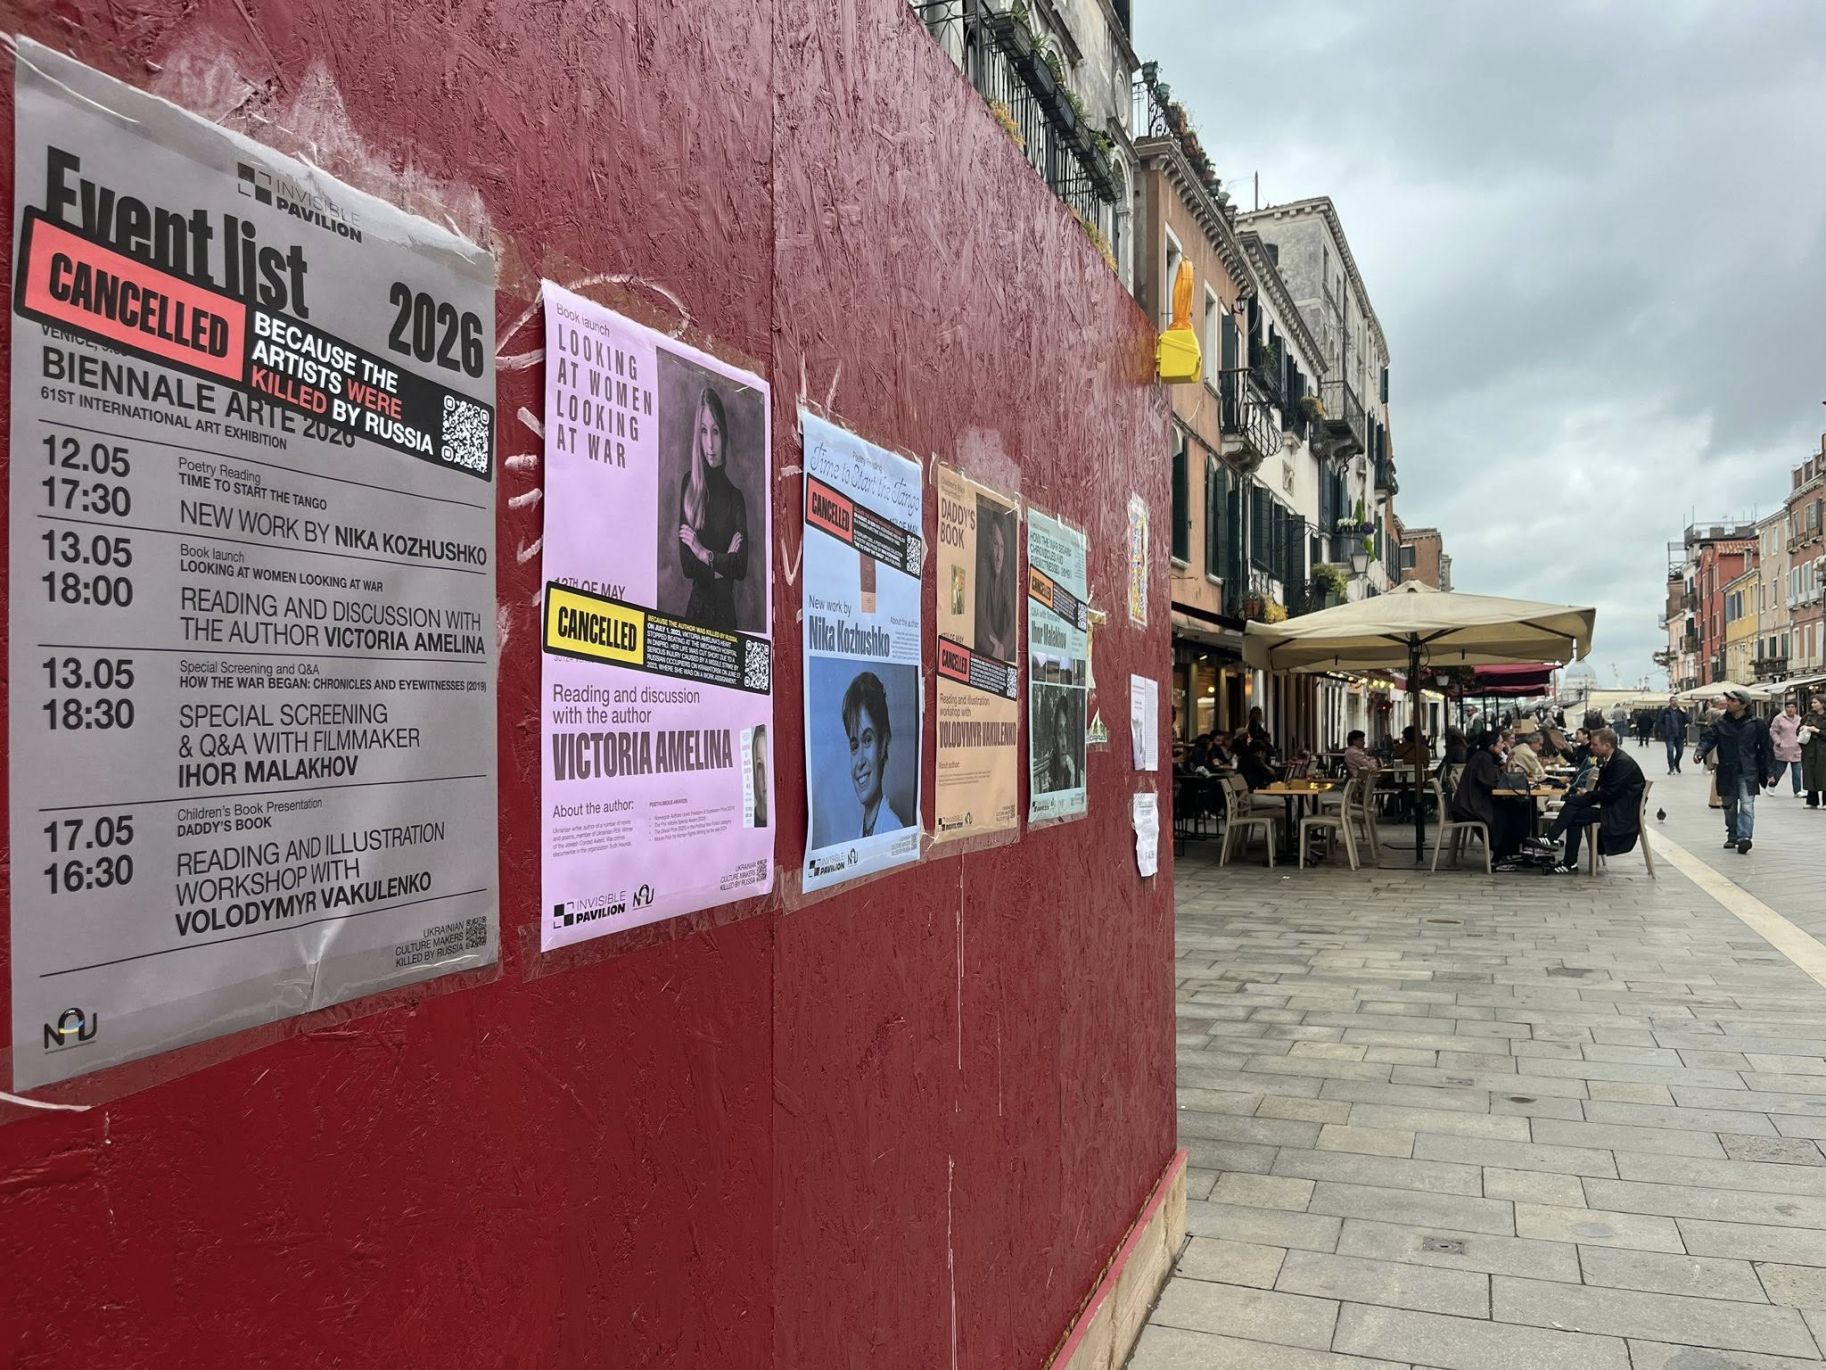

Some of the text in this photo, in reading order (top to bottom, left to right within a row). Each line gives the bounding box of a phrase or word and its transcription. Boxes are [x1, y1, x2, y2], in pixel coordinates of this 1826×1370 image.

[276, 196, 362, 243] PAVILION
[277, 179, 361, 224] INVISIBLE
[47, 145, 309, 319] Event list
[49, 252, 229, 358] CANCELLED
[556, 303, 610, 338] Book launch
[388, 281, 484, 379] 2026
[254, 311, 399, 393] BECAUSE THE
[558, 323, 638, 381] LOOKING
[43, 345, 216, 414] BIENNALE
[225, 391, 295, 434] ARTE
[251, 340, 402, 420] ARTISTS WERE
[557, 357, 652, 416] AT WOMEN
[41, 386, 287, 450] 61ST INTERNATIONAL ART EXHIBITION
[251, 365, 434, 455] KILLED BY RUSSIA
[556, 390, 639, 442] LOOKING
[42, 434, 131, 478] 12.05
[556, 424, 626, 469] AT WAR
[178, 457, 261, 486] Poetry Reading
[810, 443, 838, 479] Time
[841, 464, 849, 483] to
[851, 464, 876, 494] Start
[892, 477, 919, 518] Tango
[42, 476, 131, 517] 17:30
[178, 473, 327, 511] TIME TO START THE TANGO
[811, 492, 849, 533] CANCELLED
[941, 497, 976, 531] DADDY'S
[42, 529, 132, 568] 13.05
[180, 500, 487, 566] NEW WORK BY NIKA KOZHUSHKO
[940, 522, 965, 550] BOOK
[180, 544, 245, 563] Book launch
[42, 571, 133, 608] 18:00
[180, 559, 383, 593] LOOKING AT WOMEN LOOKING AT WAR
[601, 583, 626, 600] MAY
[181, 587, 481, 632] READING AND DISCUSSION WITH
[809, 594, 852, 617] New work by
[180, 617, 486, 655] THE AUTHOR VICTORIA AMELINA
[557, 606, 637, 652] CANCELLED
[678, 621, 696, 631] AUTHOR
[809, 615, 835, 652] Nika
[837, 620, 890, 658] Kozhushko
[43, 657, 134, 689] 13.05
[180, 660, 319, 677] Special Screening and Q&A
[180, 676, 487, 693] HOW THE WAR BEGAN: CHRONICLES AND EYEWITNESSES (2019)
[43, 698, 134, 730] 18:30
[553, 684, 700, 706] Reading and discussion
[179, 703, 388, 728] SPECIAL SCREENING
[553, 707, 652, 724] with the author
[940, 721, 982, 748] VOLODYMYR
[179, 728, 420, 758] & Q&A WITH FILMMAKER
[552, 729, 733, 781] VICTORIA AMELINA
[178, 755, 358, 788] IHOR MALAKHOV
[177, 797, 323, 823] Children's Book Presentation
[177, 816, 272, 838] DADDY'S BOOK
[553, 804, 583, 818] About
[586, 802, 601, 814] the
[603, 800, 634, 813] author:
[43, 814, 134, 852] 17.05
[177, 821, 445, 877] READING AND ILLUSTRATION
[43, 854, 134, 895] 16:30
[176, 857, 360, 906] WORKSHOP WITH
[820, 862, 845, 876] PAVILION
[175, 871, 432, 937] VOLODYMYR VAKULENKO
[576, 903, 626, 924] PAVILION
[577, 890, 627, 911] INVISIBLE
[395, 932, 464, 957] CULTURE MAKERS
[423, 921, 464, 938] UKRAINIAN
[395, 943, 464, 968] KILLED BY RUSSIA
